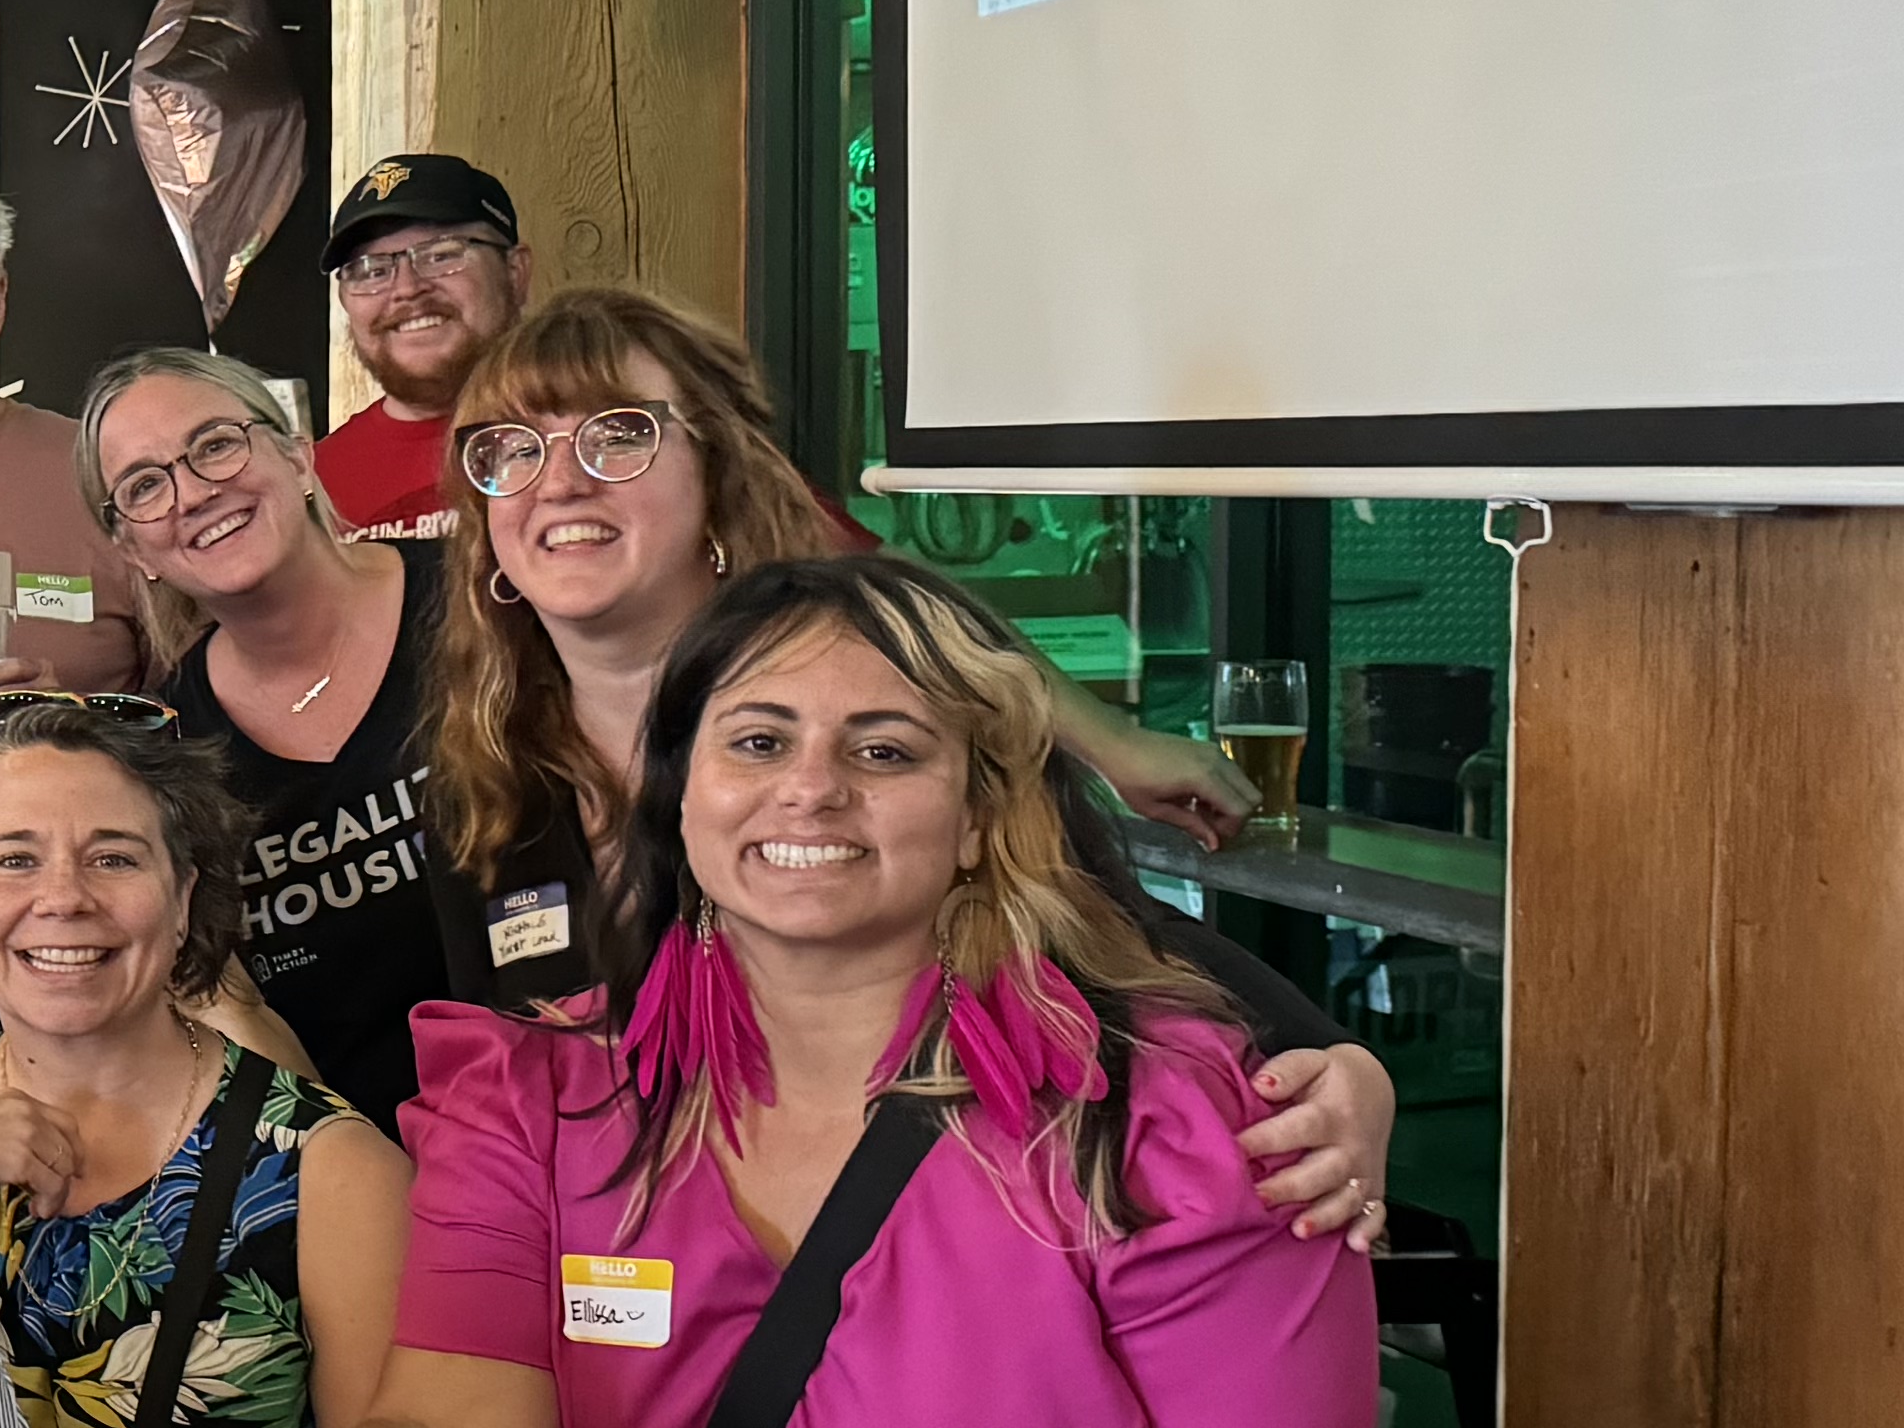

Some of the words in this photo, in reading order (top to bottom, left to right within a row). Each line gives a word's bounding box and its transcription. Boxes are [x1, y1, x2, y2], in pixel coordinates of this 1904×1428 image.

[37, 575, 70, 587] HELLO
[24, 587, 65, 607] Tom
[236, 765, 431, 886] LEGALI
[503, 890, 539, 911] HELLO
[589, 1259, 638, 1278] HELLO
